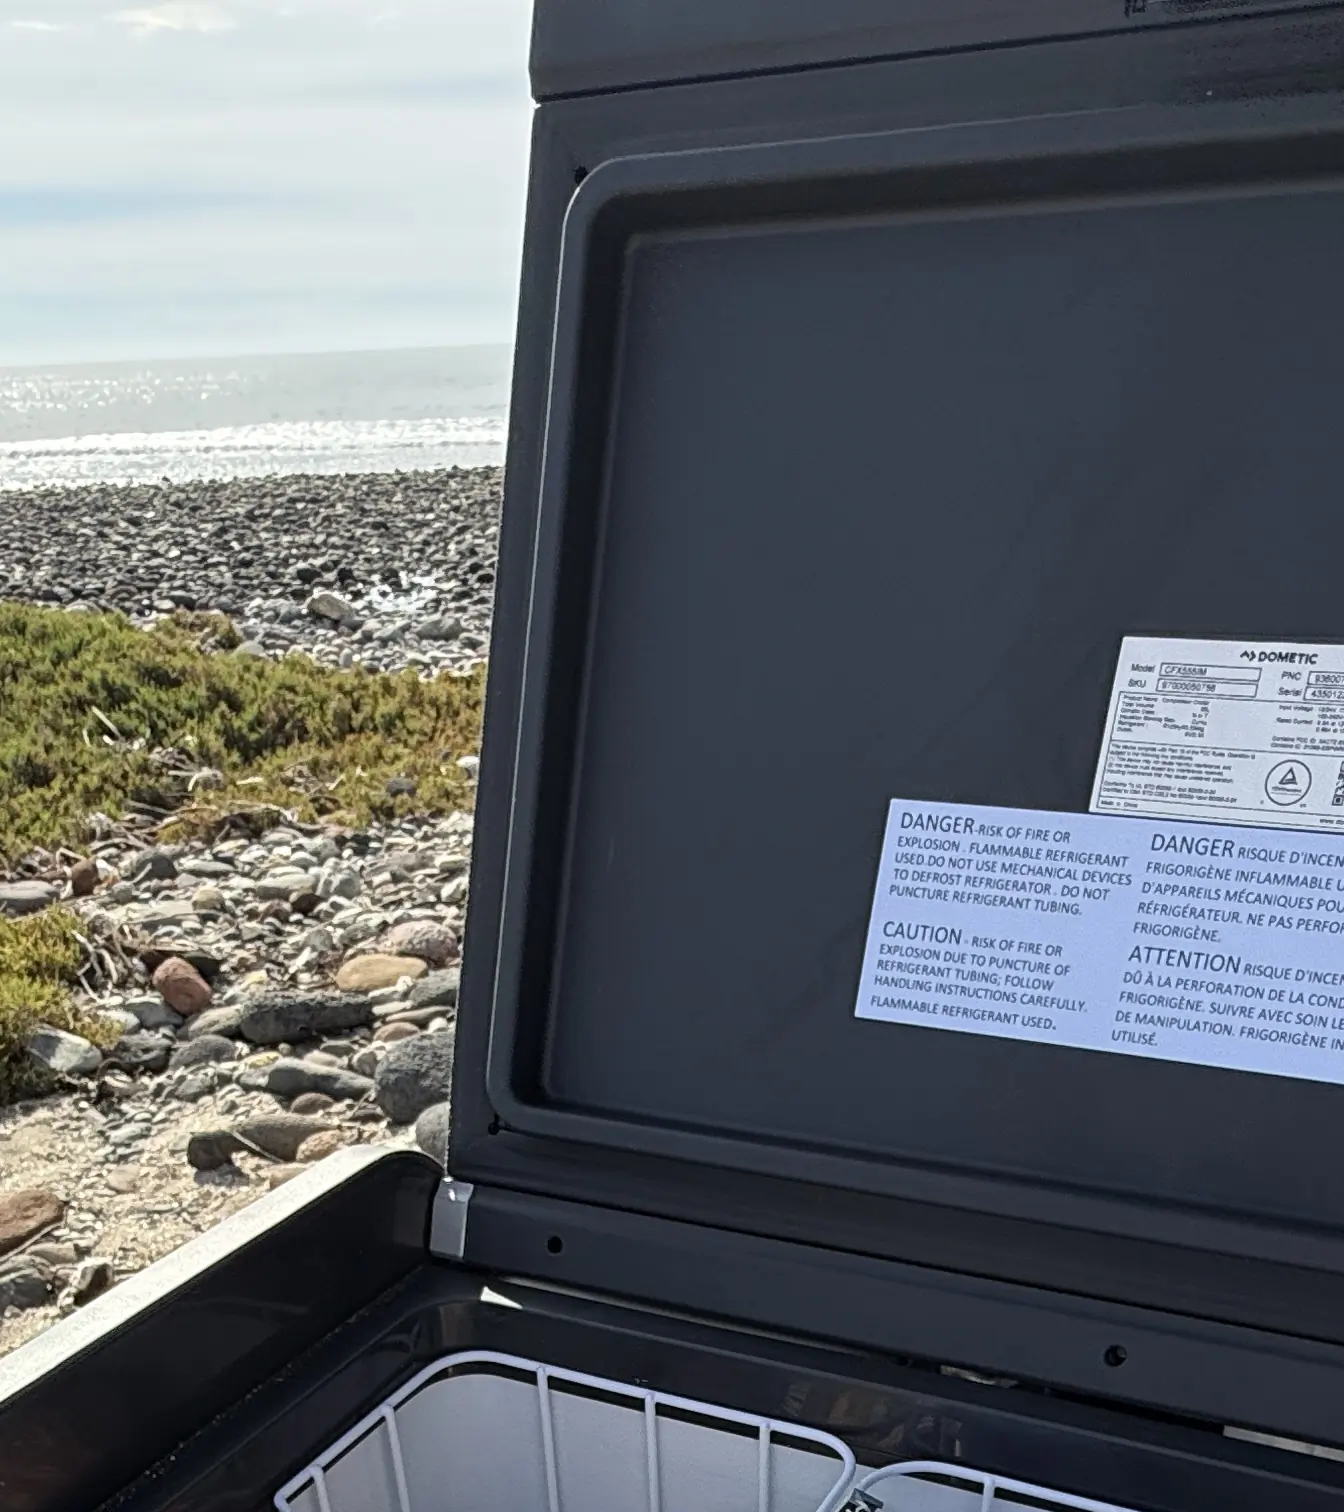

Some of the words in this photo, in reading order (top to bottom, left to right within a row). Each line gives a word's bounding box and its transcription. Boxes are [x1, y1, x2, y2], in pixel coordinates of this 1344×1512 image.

[1257, 651, 1319, 664] DOMETIC
[900, 811, 975, 835] DANGER
[1005, 826, 1023, 839] OF
[1024, 827, 1051, 842] FIRE
[1052, 830, 1071, 844] OR
[897, 835, 961, 853] EXPLOSION
[969, 842, 1043, 860] FLAMMABLE
[1045, 849, 1129, 867] REFRIGERANT
[1151, 833, 1235, 858] DANGER
[1237, 846, 1287, 863] RISQUE
[894, 867, 909, 881] TO
[911, 870, 962, 886] DEFROST
[964, 875, 1052, 895] REFRIGERATOR
[1060, 884, 1080, 898] DO
[1082, 887, 1111, 901] NOT
[947, 856, 973, 870] NOT
[975, 860, 998, 873] USE
[1000, 862, 1078, 881] MECHANICAL
[1081, 869, 1132, 886] DEVICES
[1146, 861, 1232, 881] FRIGORIGÈNE
[1235, 870, 1333, 891] INFLAMMABLE
[889, 884, 949, 902] PUNCTURE
[952, 890, 1031, 909] REFRIGERANT
[1224, 888, 1314, 910] MÉCANIQUES
[1246, 912, 1266, 927] NE
[1267, 914, 1293, 930] PAS
[883, 921, 962, 945] CAUTION
[971, 935, 997, 949] RISK
[998, 939, 1015, 952] OF
[1017, 941, 1043, 955] FIRE
[1044, 944, 1063, 957] OR
[879, 943, 941, 961] EXPLOSION
[943, 950, 968, 965] DUE
[970, 953, 987, 967] TO
[988, 956, 1051, 975] PUNCTURE
[1054, 964, 1071, 976] OF
[1128, 945, 1241, 974] ATTENTION
[1243, 963, 1292, 980] RISQUE
[874, 975, 932, 993] HANDLING
[935, 983, 1017, 1004] INSTRUCTIONS
[876, 959, 952, 978] REFRIGERANT
[1004, 974, 1055, 991] FOLLOW
[1123, 970, 1143, 985] DÛ
[1143, 971, 1154, 986] À
[1157, 975, 1172, 988] LA
[1175, 978, 1265, 999] PERFORATION
[1267, 988, 1286, 1002] DE
[1288, 991, 1305, 1005] LA
[870, 995, 939, 1015] FLAMMABLE
[941, 1005, 1019, 1024] REFRIGERANT
[1209, 1001, 1255, 1019] SUIVRE
[1257, 1008, 1294, 1024] AVEC
[1294, 1012, 1329, 1028] SOIN
[1114, 1010, 1133, 1024] DE
[1239, 1026, 1328, 1049] FRIGORIGÈNE
